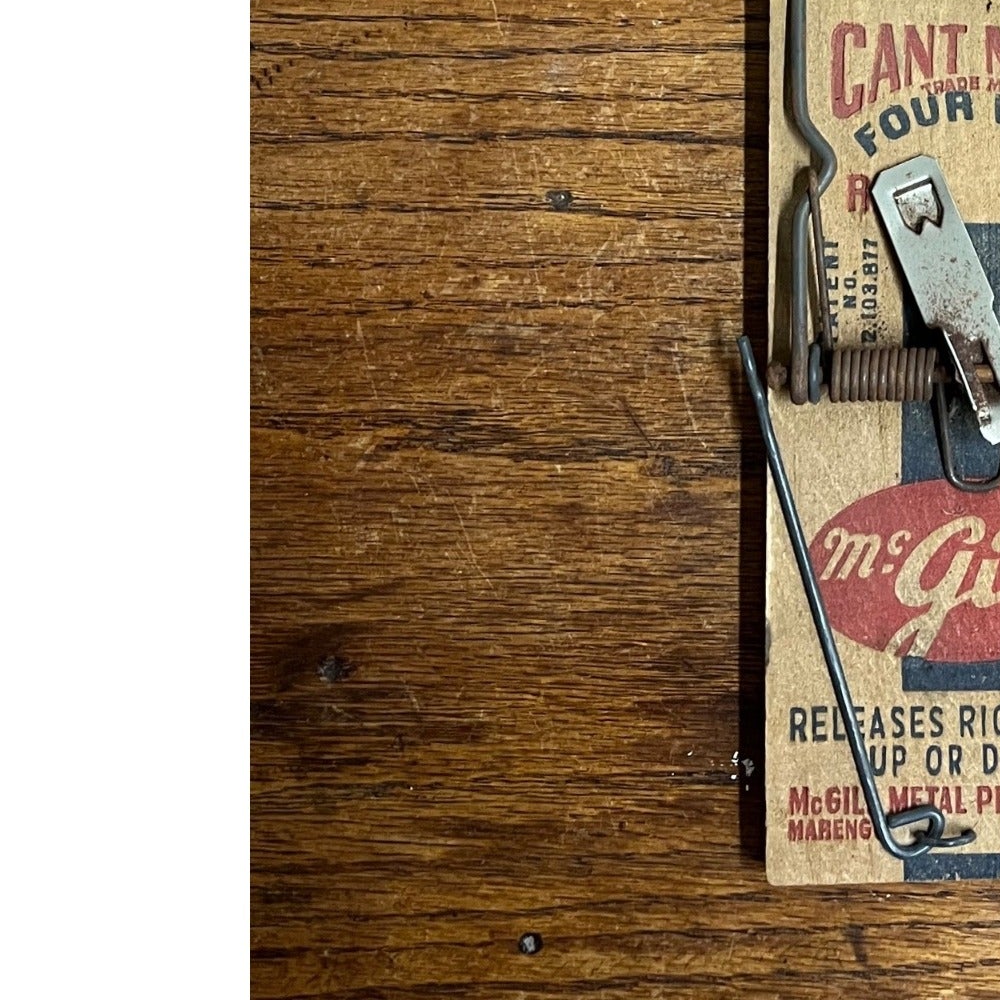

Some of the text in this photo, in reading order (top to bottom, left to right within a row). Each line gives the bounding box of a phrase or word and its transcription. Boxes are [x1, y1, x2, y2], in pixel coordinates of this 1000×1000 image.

[831, 22, 967, 119] CANT
[921, 76, 980, 96] TRADE
[854, 91, 974, 158] FOUR
[842, 270, 857, 308] NO.
[869, 745, 906, 777] UP
[926, 744, 962, 776] OR
[788, 786, 865, 816] McGIL
[888, 786, 967, 815] METAL
[787, 819, 872, 842] MARENG
